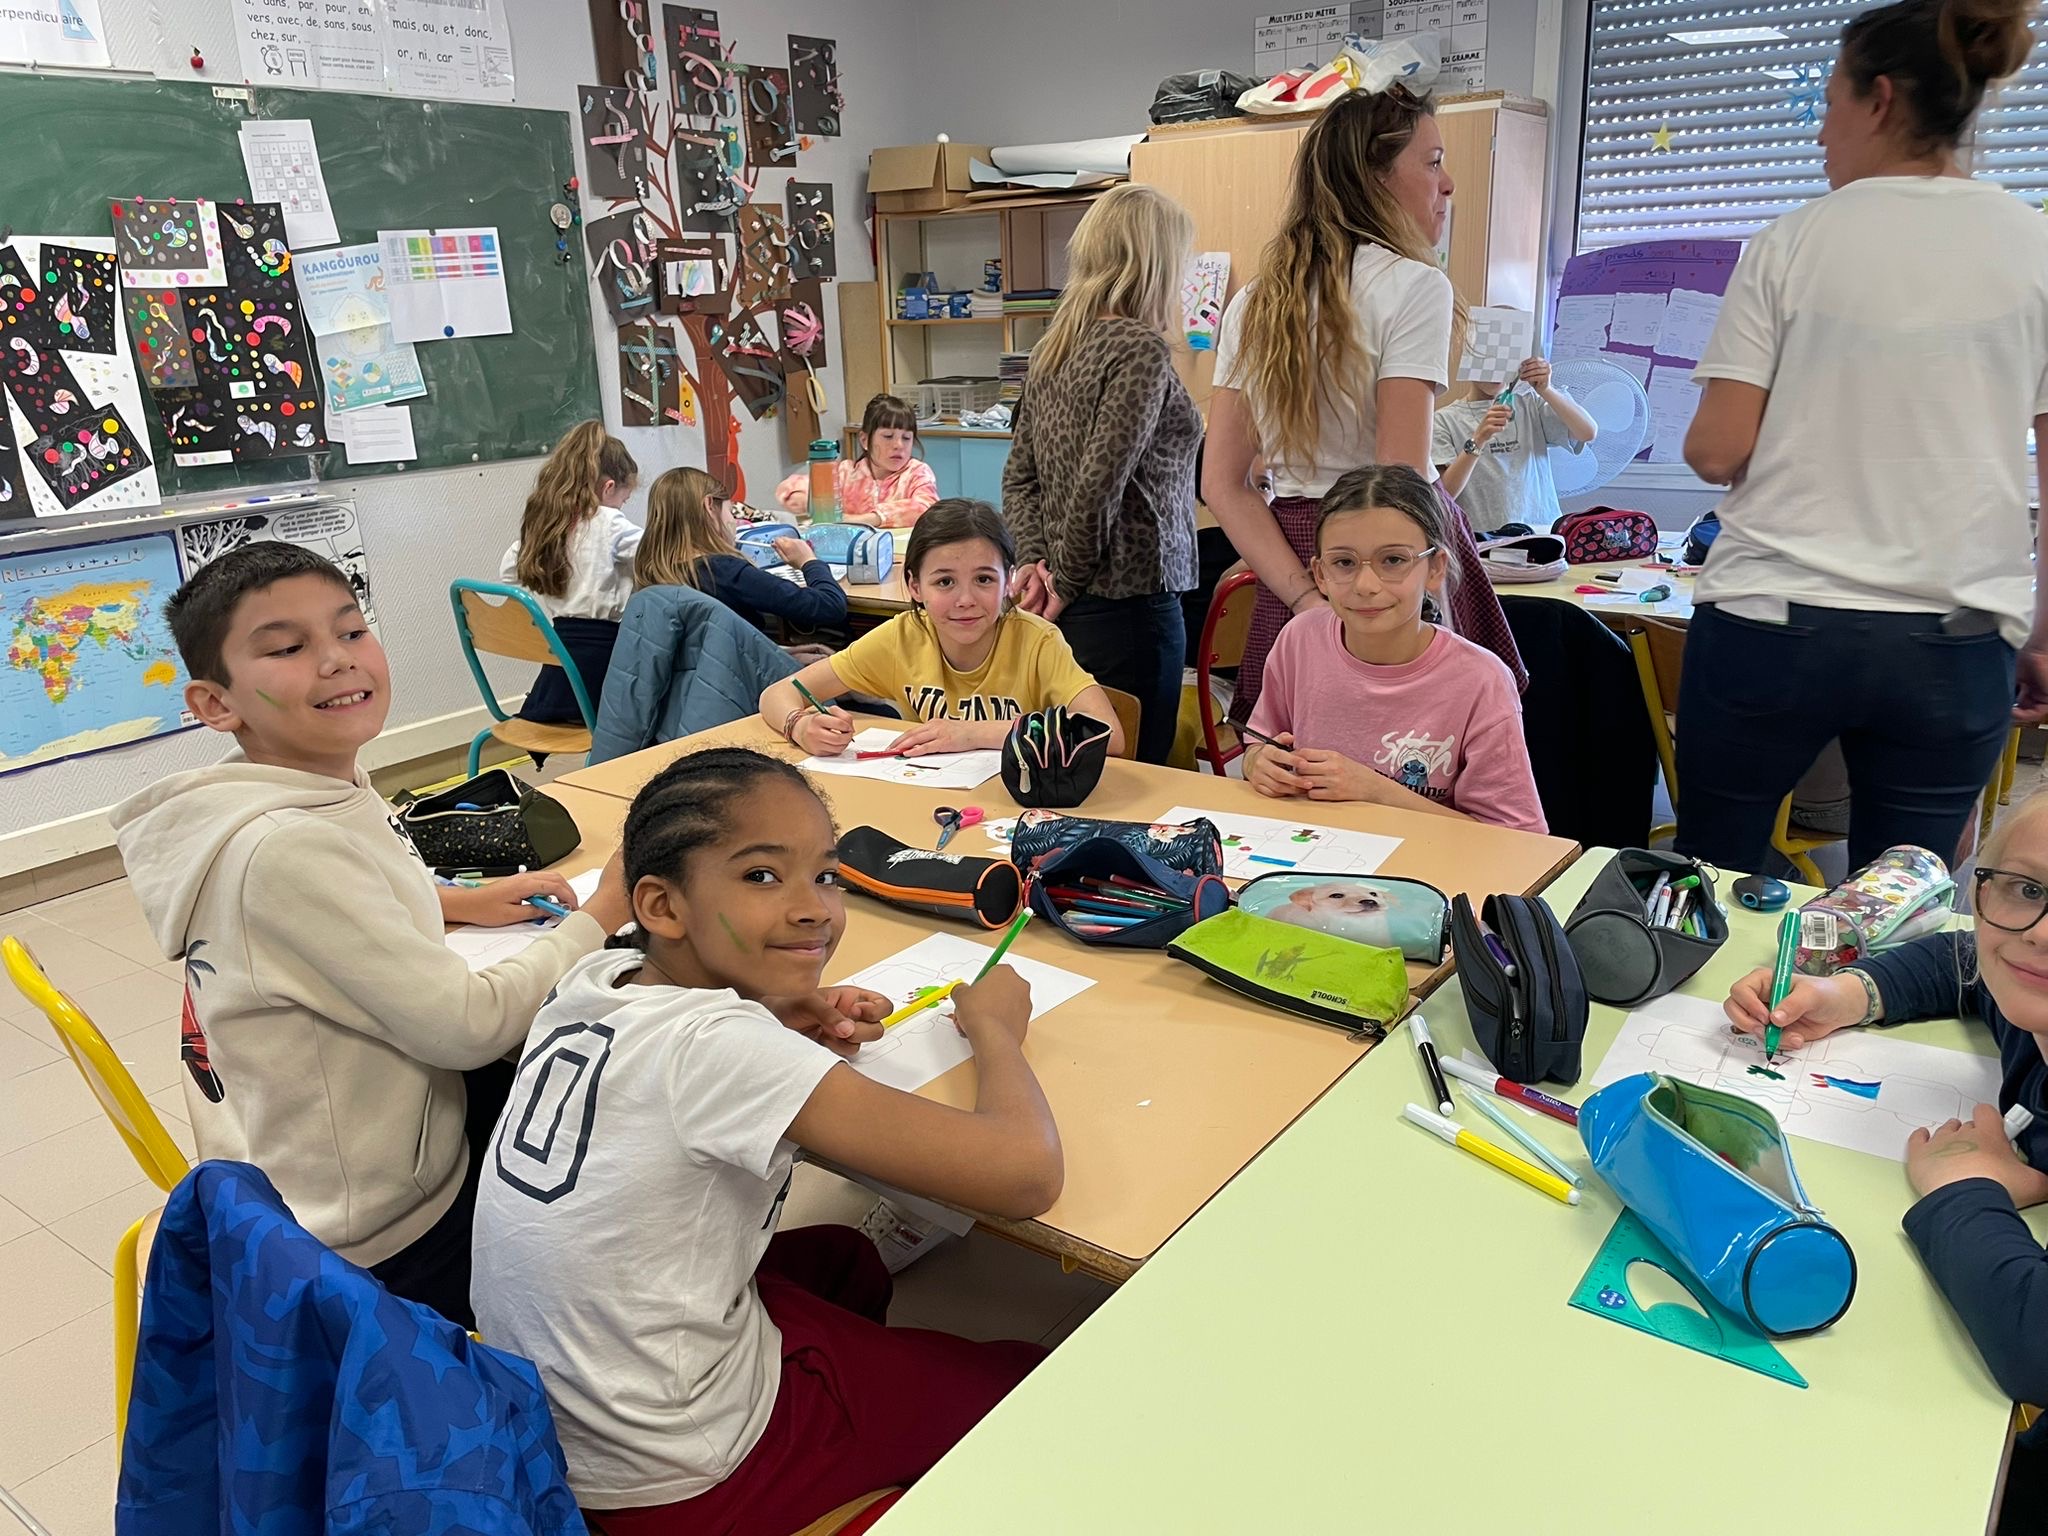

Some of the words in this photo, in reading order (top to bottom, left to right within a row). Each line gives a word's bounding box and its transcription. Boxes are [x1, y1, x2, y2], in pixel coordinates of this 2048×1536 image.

[299, 1, 317, 12] par,
[326, 3, 350, 15] pour,
[358, 7, 373, 17] en,
[247, 13, 274, 25] vers,
[277, 16, 303, 27] avec,
[306, 17, 321, 29] de,
[324, 20, 349, 31] sans,
[352, 22, 376, 34] sous,
[1269, 13, 1303, 24] MULTIPLES
[1305, 11, 1314, 19] DU
[1428, 18, 1441, 26] cm
[1462, 13, 1477, 21] mm
[392, 18, 420, 32] mais,
[422, 23, 438, 35] ou,
[443, 25, 459, 37] et,
[464, 25, 492, 40] donc,
[1394, 22, 1406, 31] dm
[251, 29, 279, 42] chez,
[281, 33, 301, 44] sur,
[1326, 32, 1342, 41] dam
[397, 48, 413, 60] or,
[418, 49, 431, 62] ni,
[436, 53, 453, 63] car
[1441, 55, 1452, 64] DU
[1452, 52, 1480, 62] GRAMME
[302, 253, 380, 276] KANGOUROU
